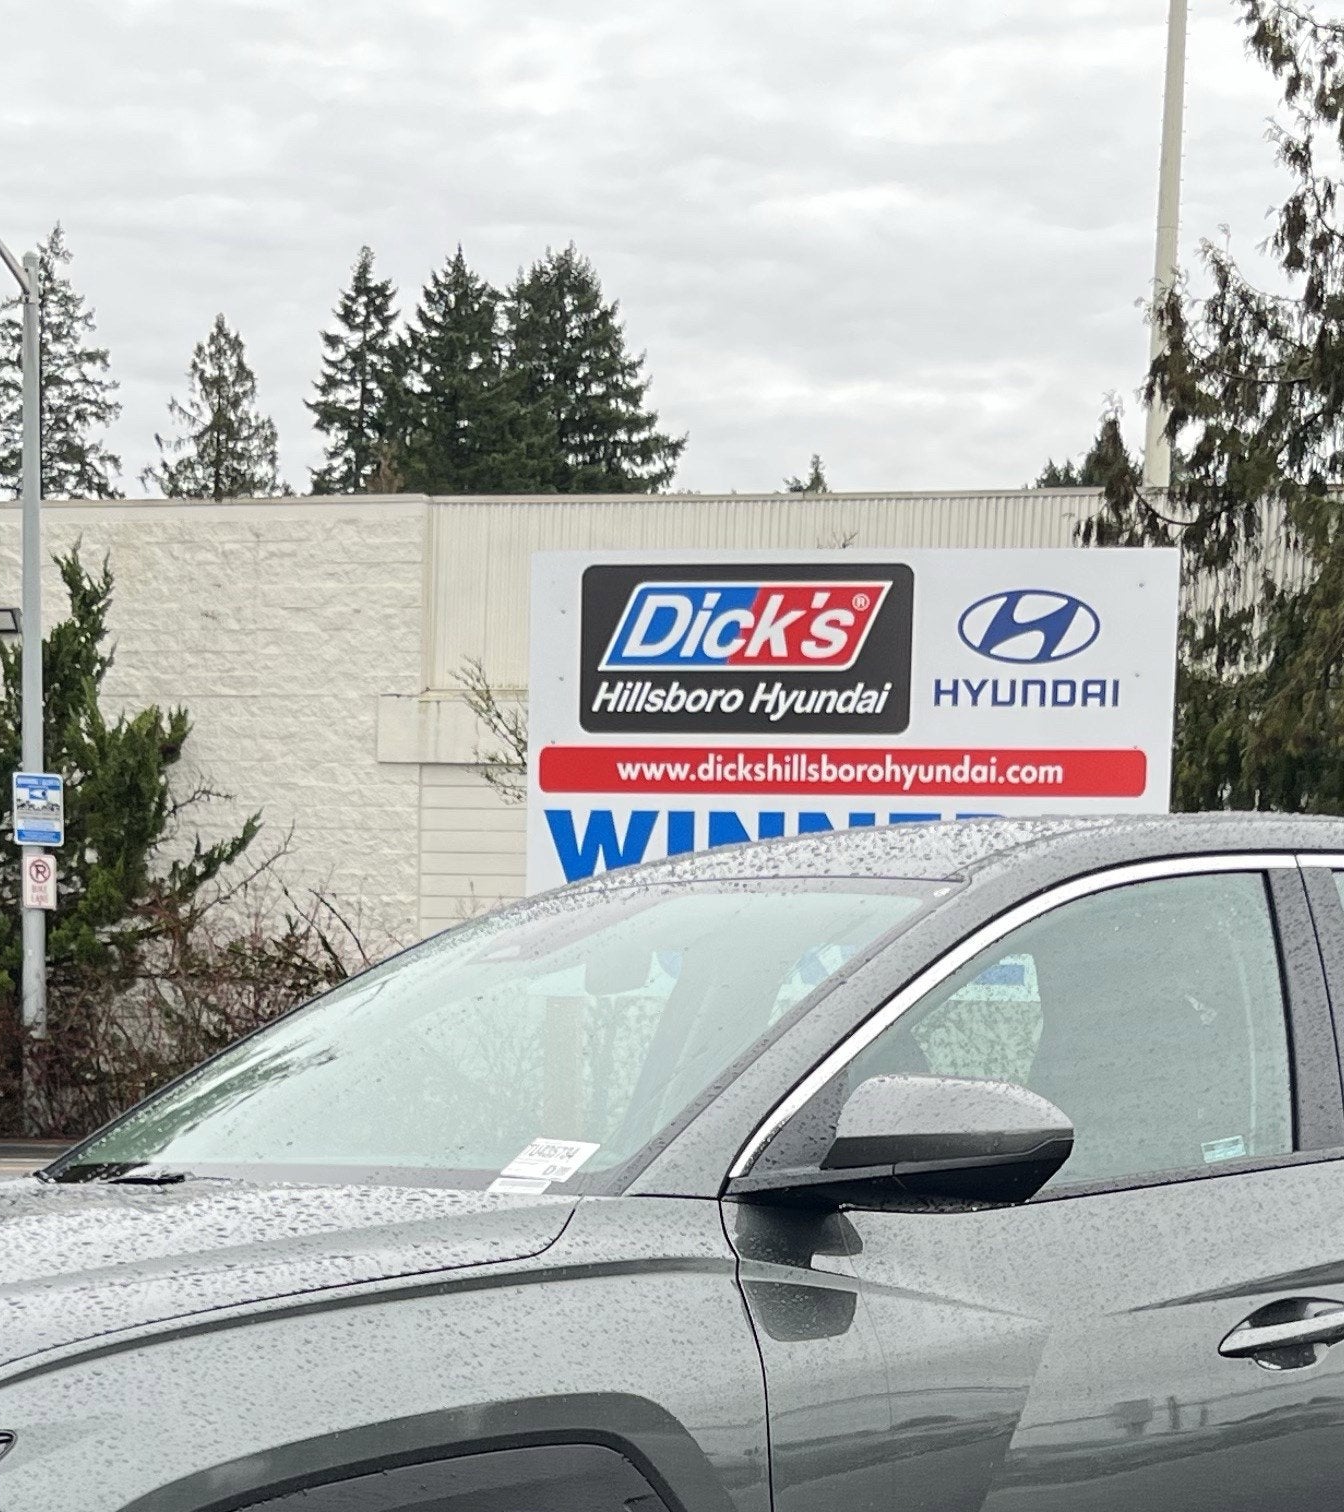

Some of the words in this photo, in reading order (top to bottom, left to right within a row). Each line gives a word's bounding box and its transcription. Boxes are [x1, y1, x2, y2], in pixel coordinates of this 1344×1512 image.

[621, 592, 856, 660] Dick's
[592, 682, 741, 714] Hillsboro
[749, 683, 891, 721] Hyundai
[934, 679, 1119, 708] HYUNDAI
[616, 753, 1064, 791] www.dickshillsborohyundai.com
